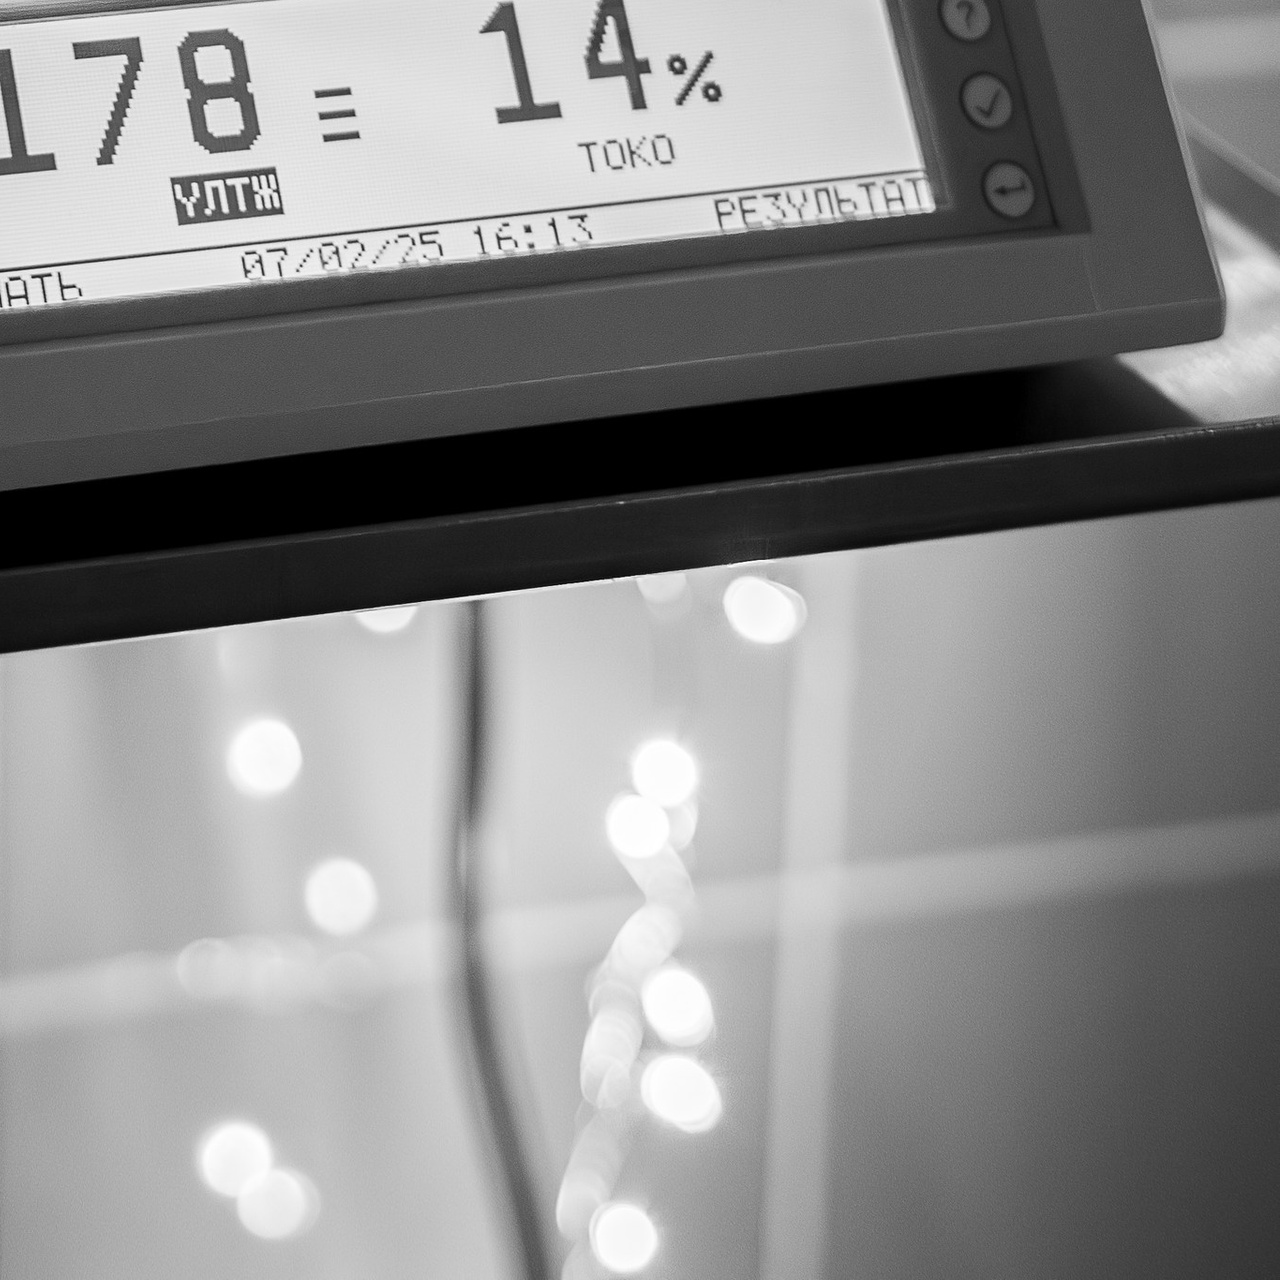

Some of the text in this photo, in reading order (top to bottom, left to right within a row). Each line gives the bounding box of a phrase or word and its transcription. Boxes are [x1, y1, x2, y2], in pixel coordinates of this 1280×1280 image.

[714, 177, 933, 232] РЕЗУЛЬТАТ
[241, 213, 595, 279] 07/02/25 16:13
